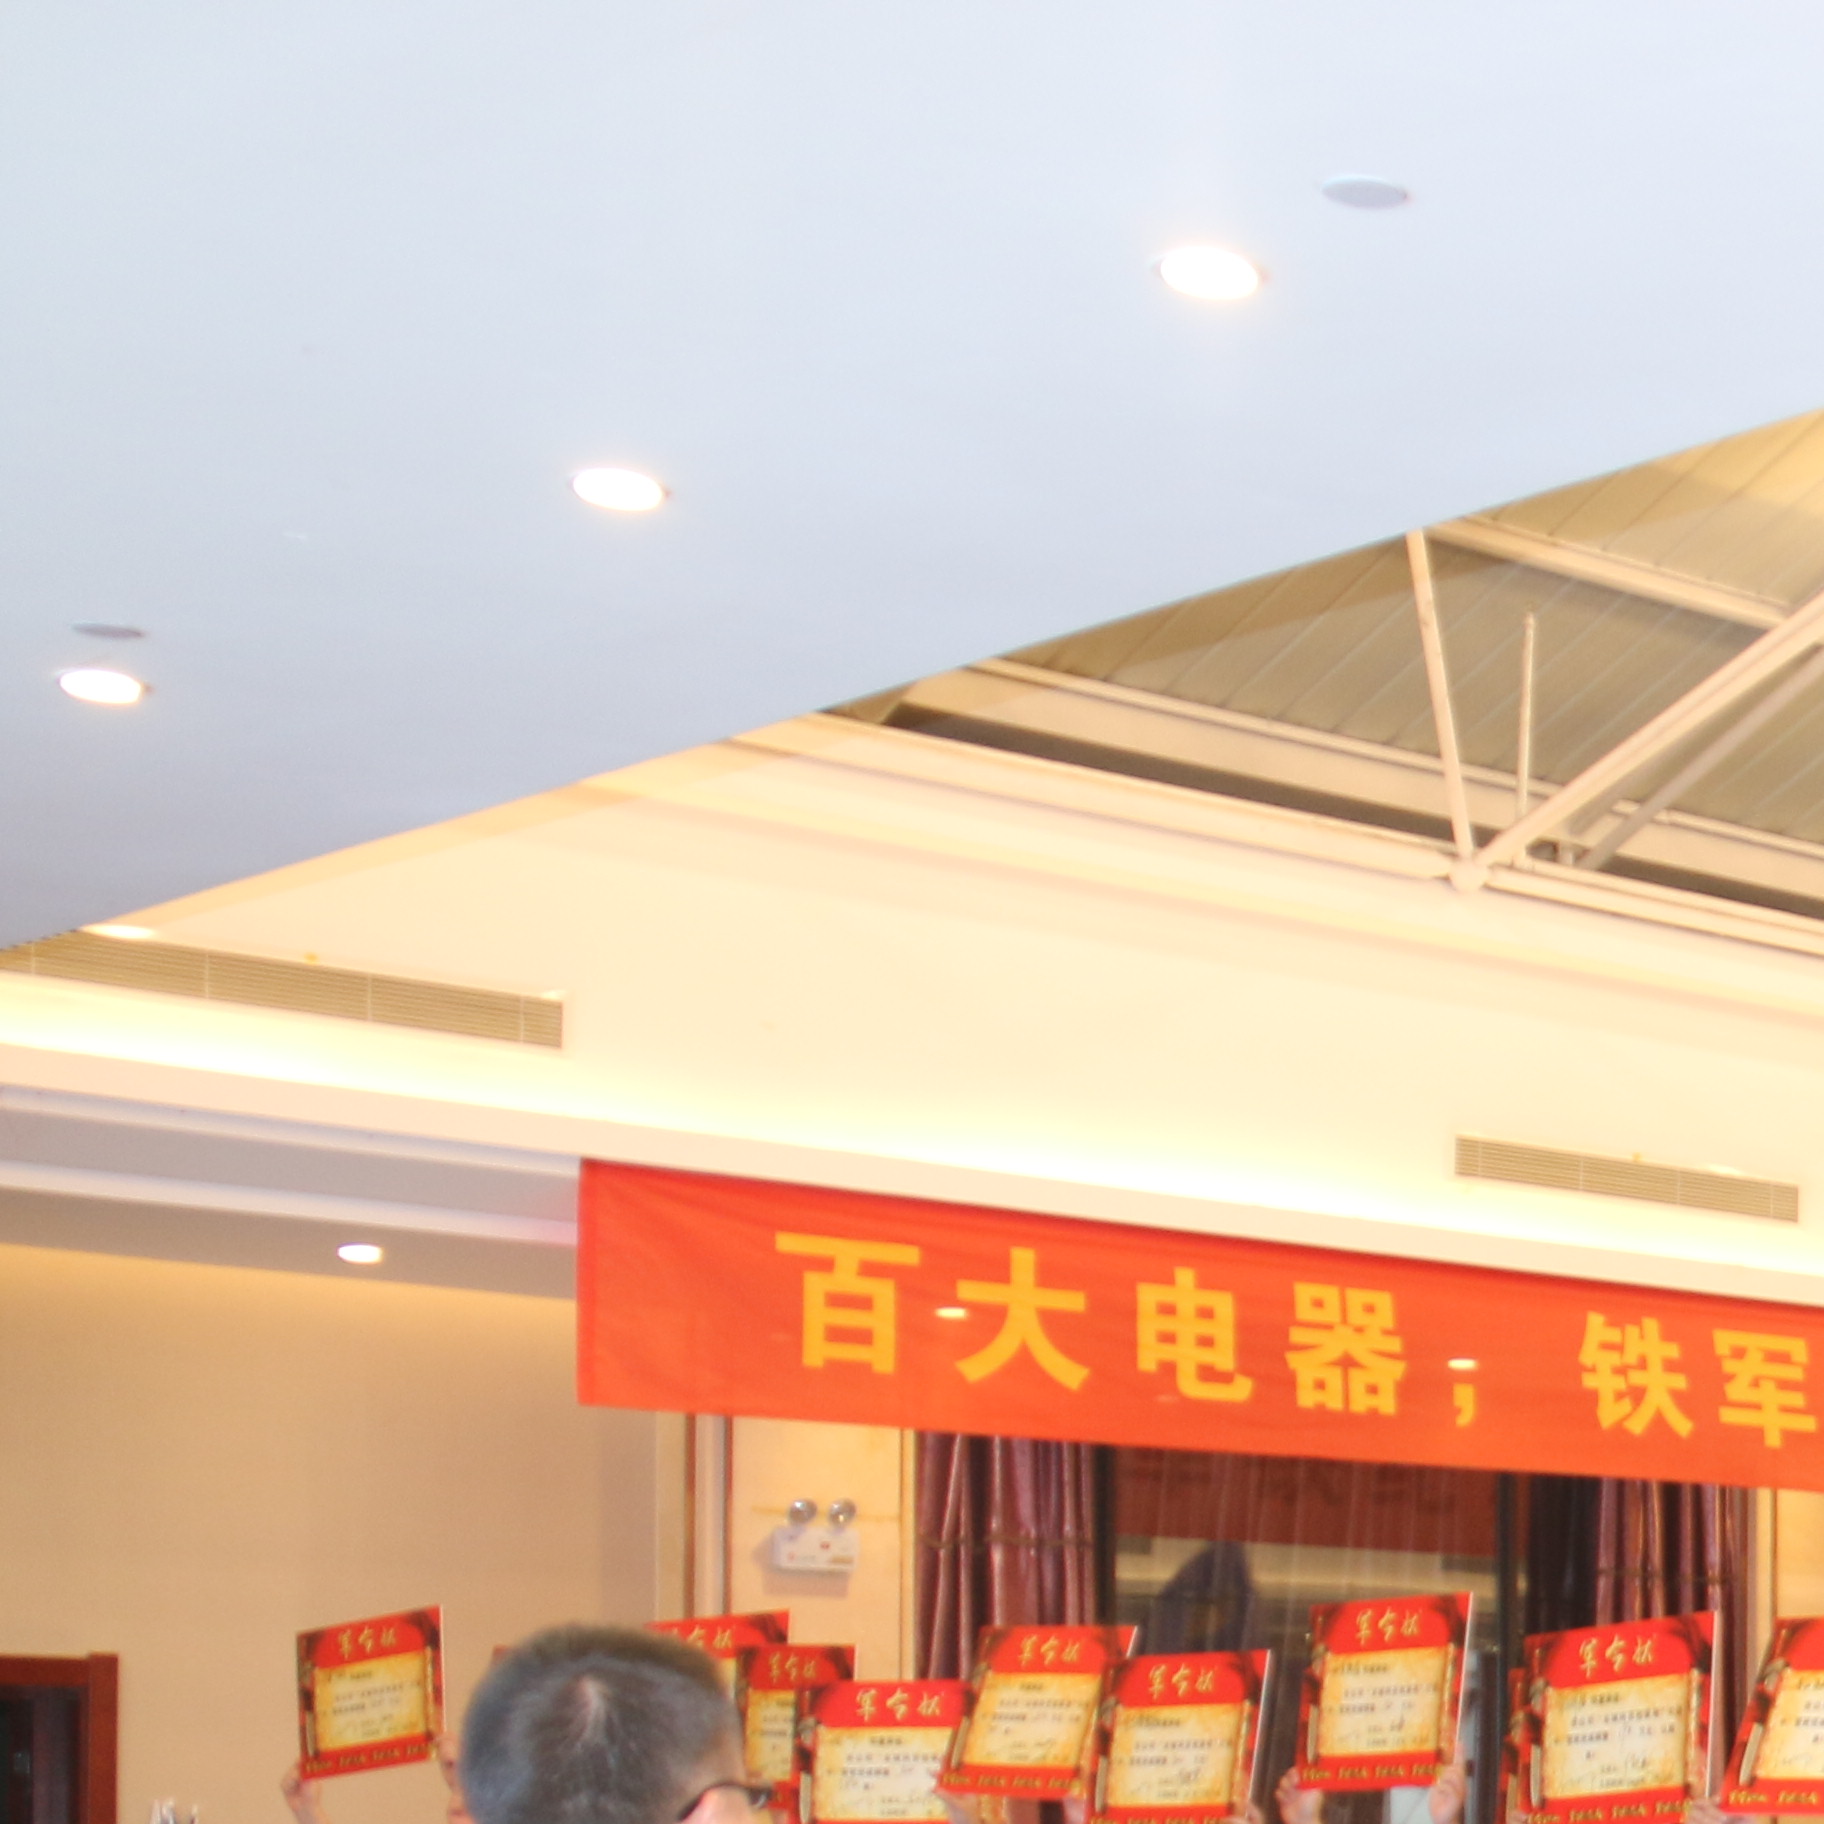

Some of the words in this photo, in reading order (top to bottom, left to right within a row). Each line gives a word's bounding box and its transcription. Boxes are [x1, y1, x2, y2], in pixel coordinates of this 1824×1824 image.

[336, 1626, 398, 1660] 军令状
[1355, 1607, 1424, 1646] 军令状
[1018, 1633, 1083, 1668] 军令状
[1578, 1633, 1658, 1678] 军令状
[1147, 1661, 1216, 1700] 军令状
[855, 1686, 945, 1722] 军令状
